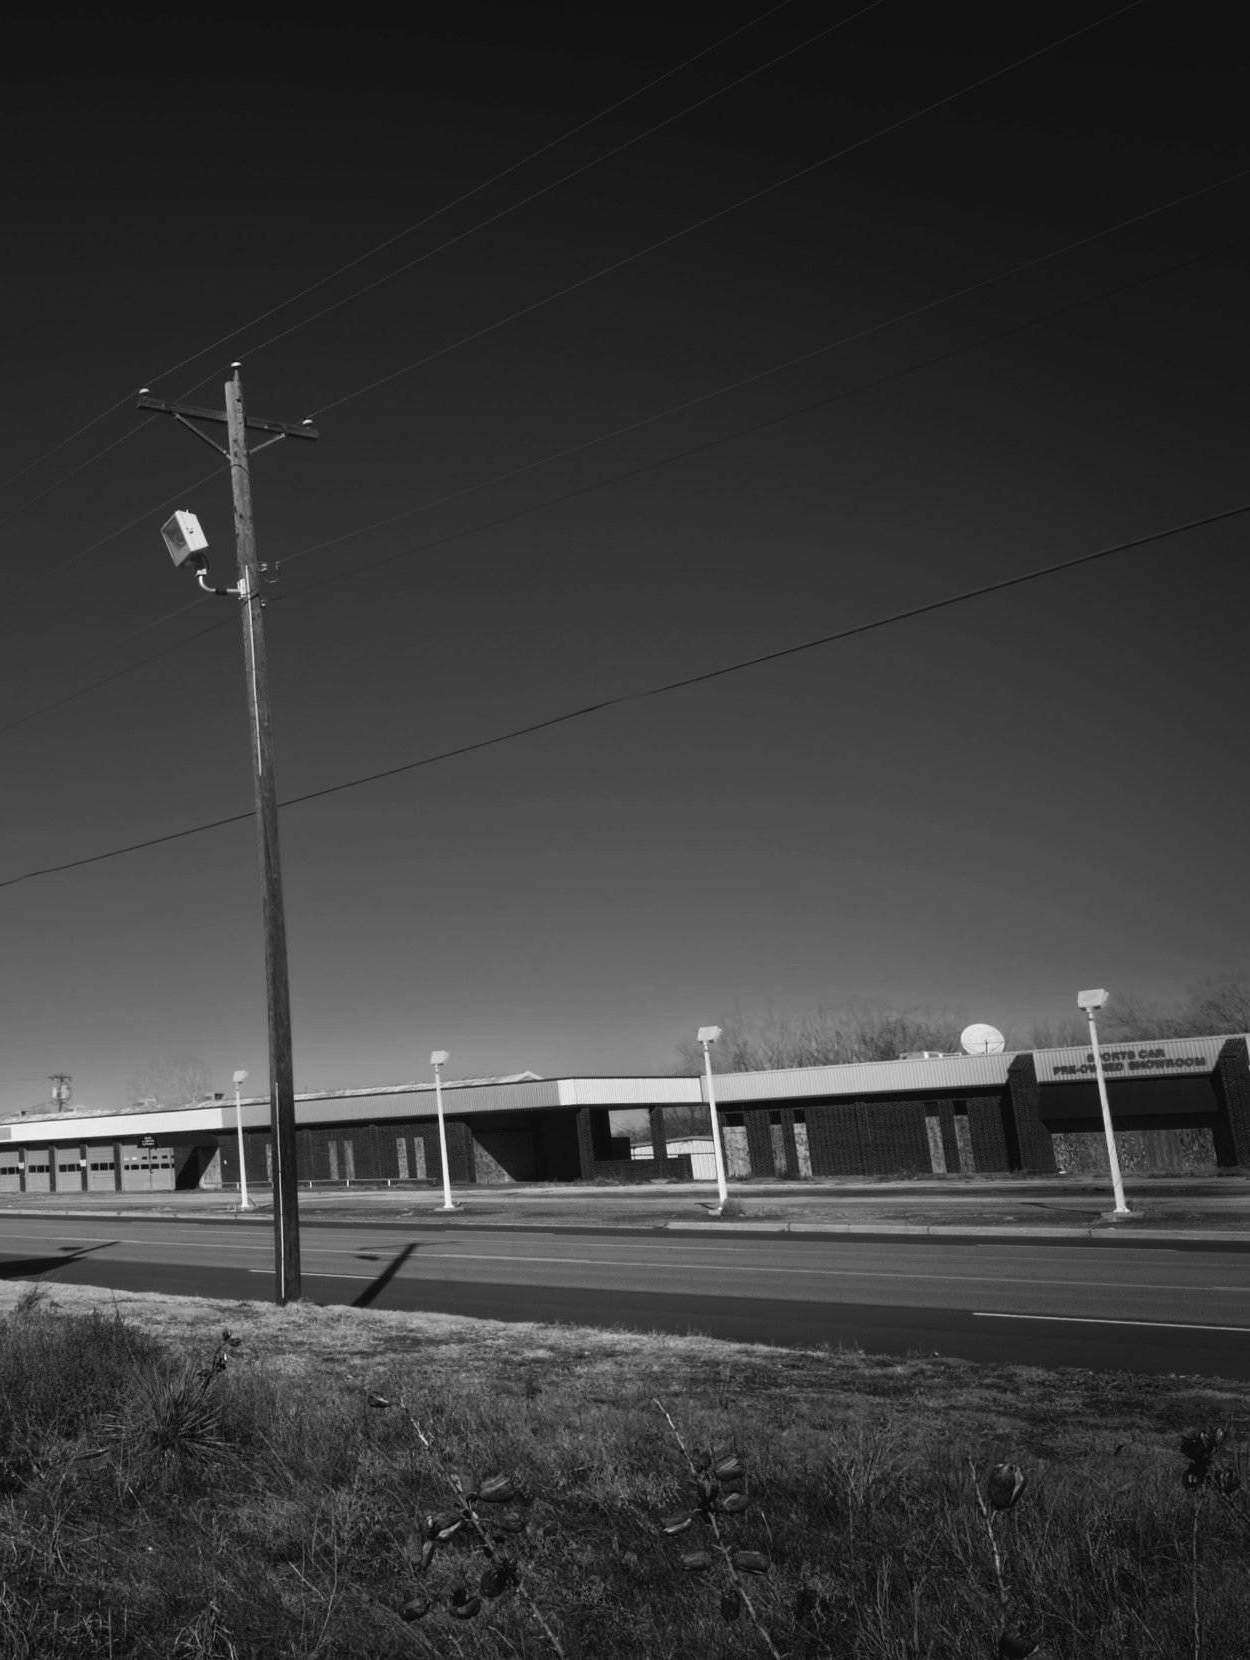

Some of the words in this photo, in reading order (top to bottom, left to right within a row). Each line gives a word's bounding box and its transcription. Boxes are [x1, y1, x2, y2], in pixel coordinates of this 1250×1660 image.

[1087, 1050, 1136, 1063] SORTS
[1138, 1048, 1165, 1059] CAR
[1128, 1057, 1206, 1071] SHOWROOM
